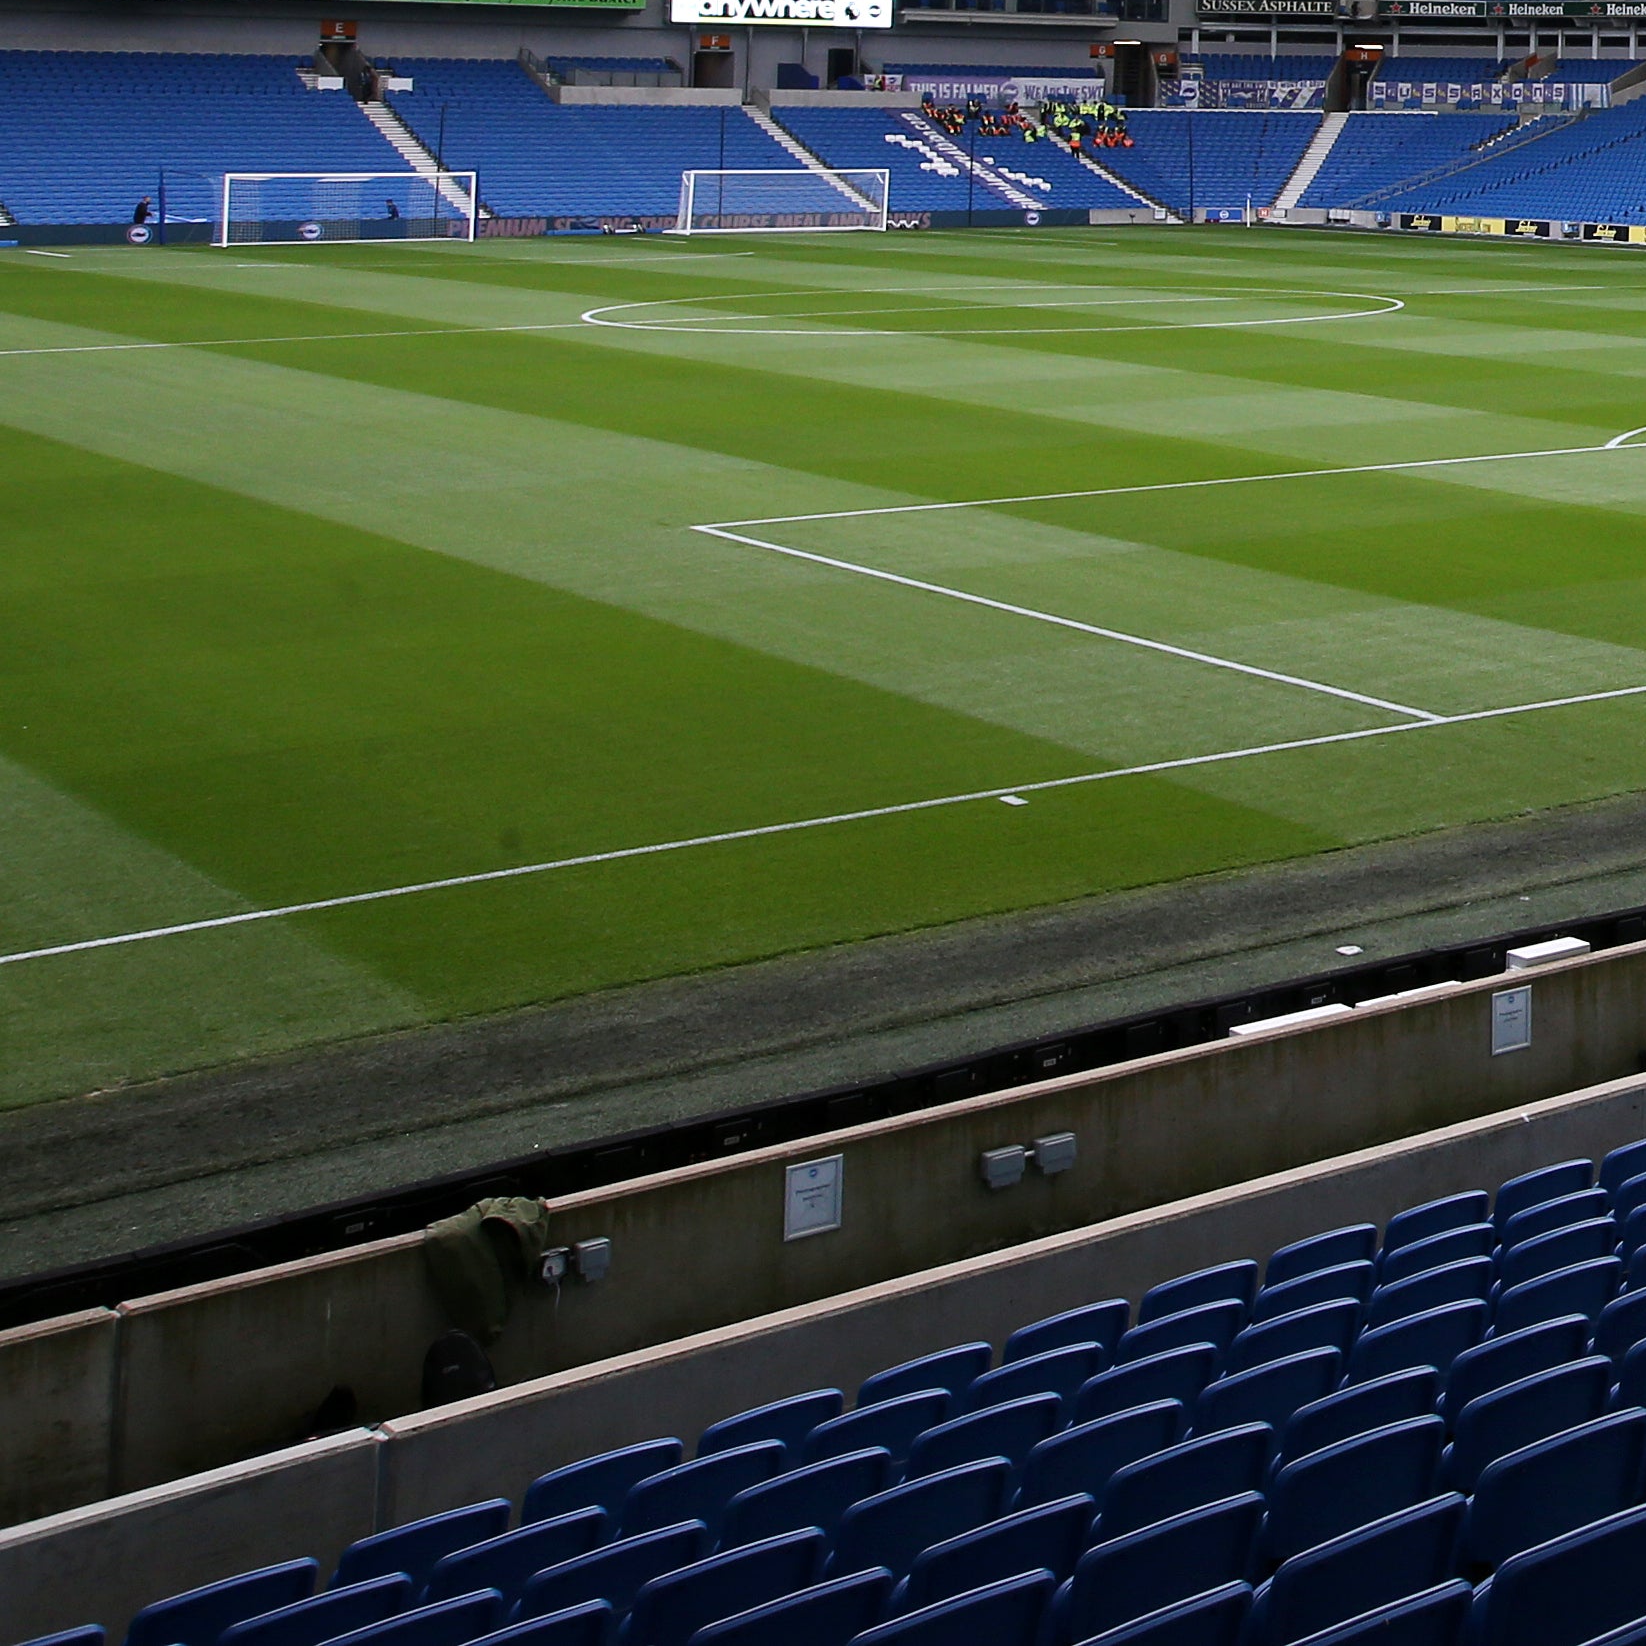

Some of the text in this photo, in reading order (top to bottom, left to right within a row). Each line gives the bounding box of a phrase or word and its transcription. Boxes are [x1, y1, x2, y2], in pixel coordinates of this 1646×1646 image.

[1259, 0, 1333, 13] ASPHALTE
[1410, 2, 1477, 16] Heineken
[1508, 2, 1565, 16] Heineken
[335, 23, 344, 34] E
[909, 82, 936, 100] THIS
[938, 83, 949, 99] IS
[952, 82, 999, 100] FALMER
[701, 214, 769, 229] COURSE
[775, 212, 823, 228] MEAL
[827, 211, 865, 228] AND
